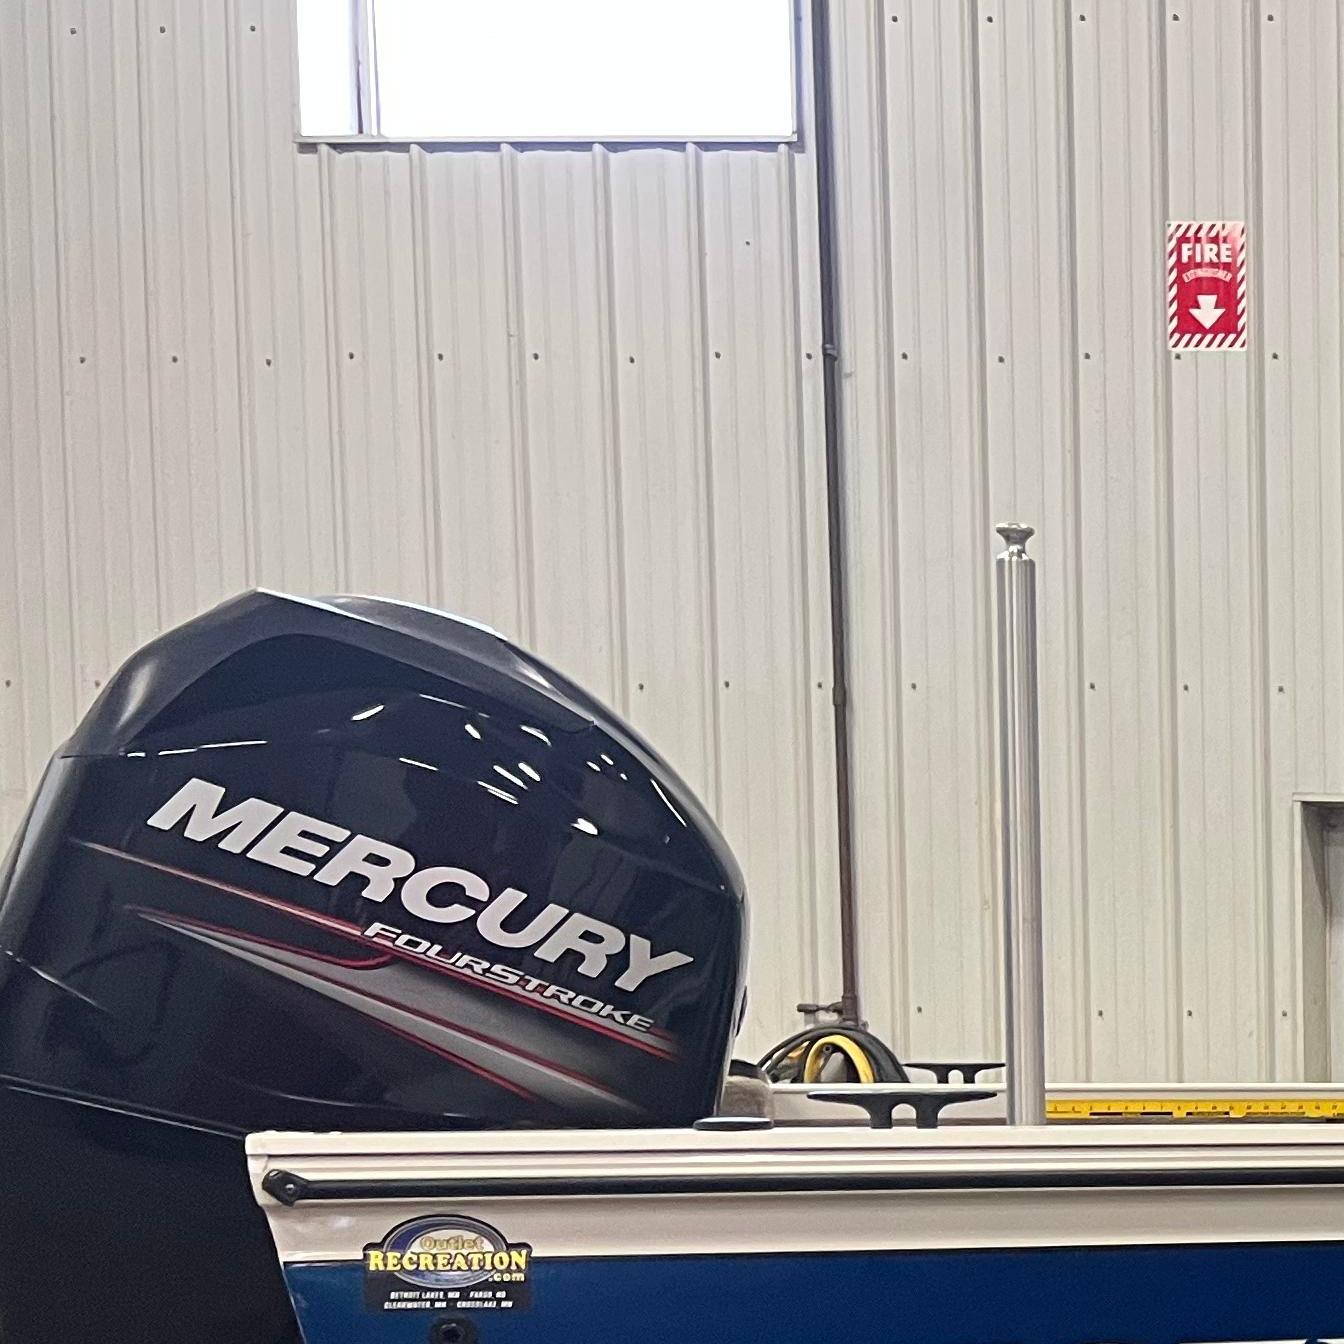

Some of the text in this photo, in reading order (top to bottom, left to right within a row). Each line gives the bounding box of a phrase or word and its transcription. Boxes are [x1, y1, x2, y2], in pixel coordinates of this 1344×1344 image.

[1181, 243, 1233, 264] FIRE
[147, 778, 694, 993] MERCURY
[362, 922, 655, 1033] FOURSTROKE
[420, 1235, 485, 1251] Outlet
[368, 1249, 528, 1272] RECREATION
[488, 1272, 525, 1283] .com
